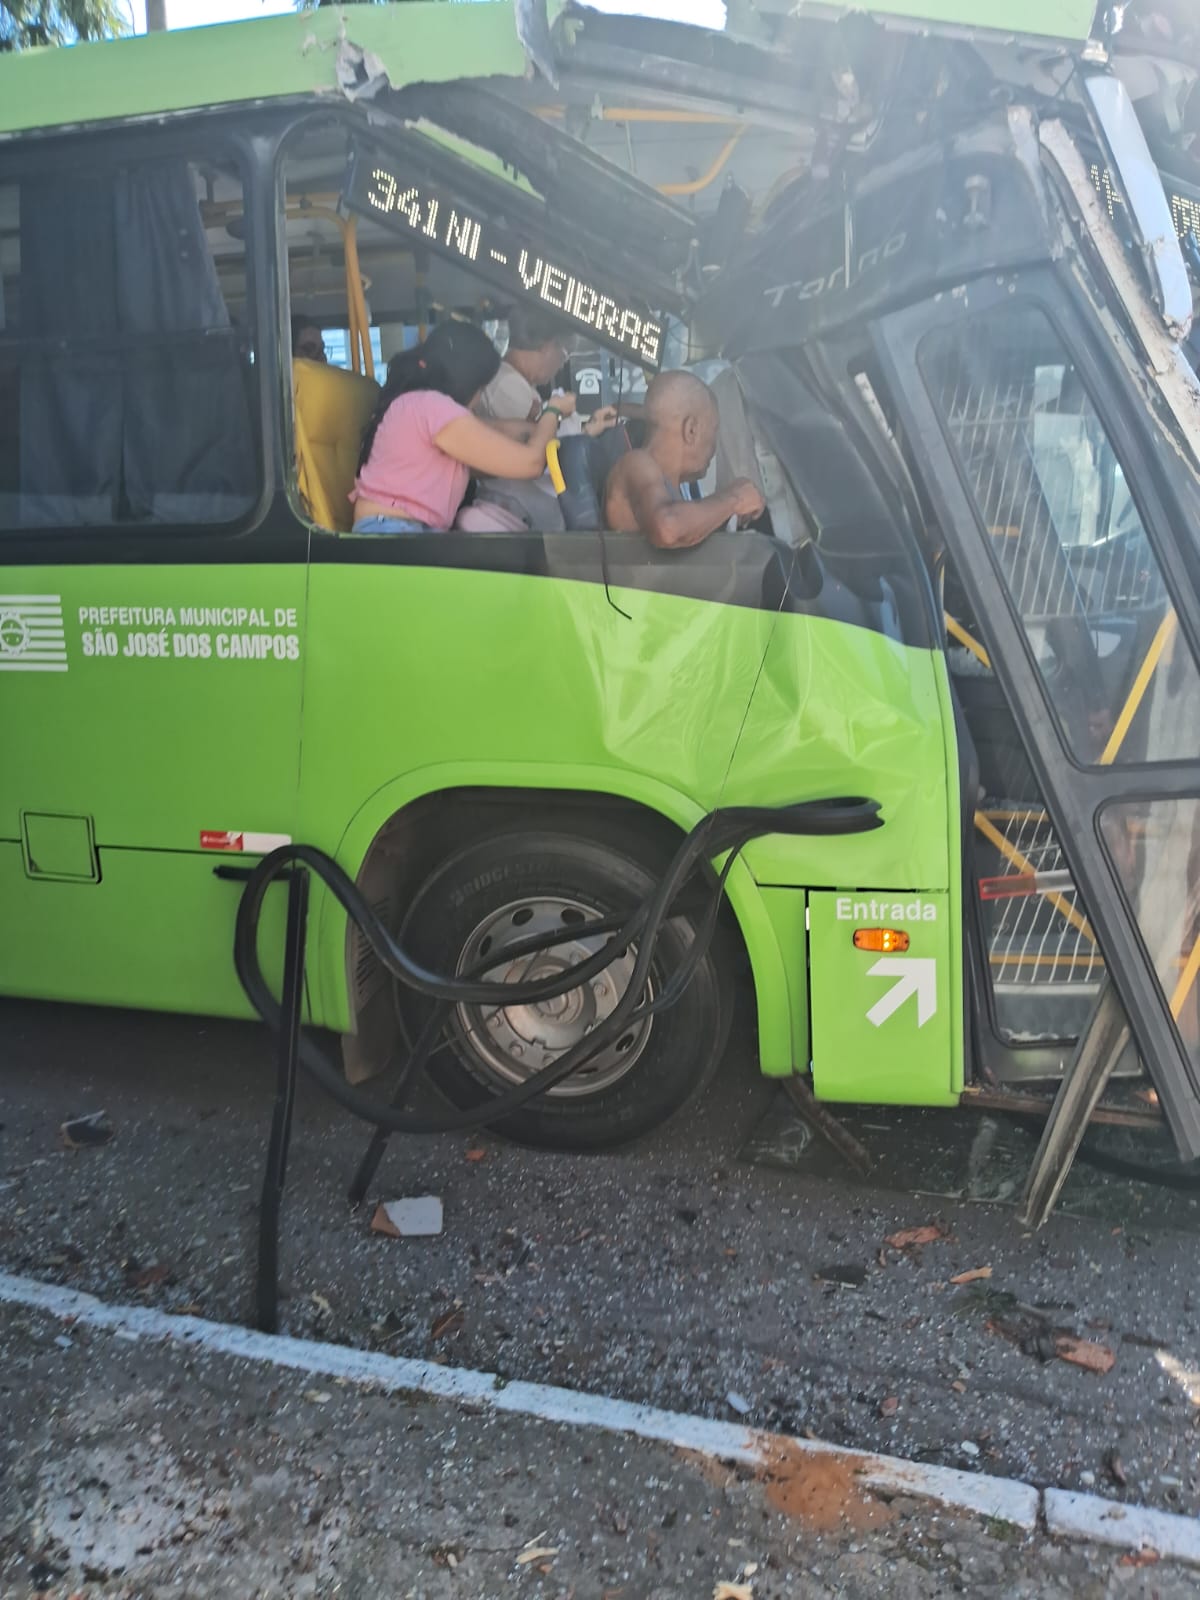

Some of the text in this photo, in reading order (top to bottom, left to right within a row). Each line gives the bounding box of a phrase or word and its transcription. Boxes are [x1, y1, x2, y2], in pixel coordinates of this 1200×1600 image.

[368, 169, 661, 360] 341 NI - VEIBRAS
[763, 231, 907, 307] Torno
[78, 606, 298, 628] PREFEITURA MUNICIPAL DE
[81, 627, 300, 660] SÃO JOSÉ DOS CAMPOS
[835, 897, 937, 921] Entrada
